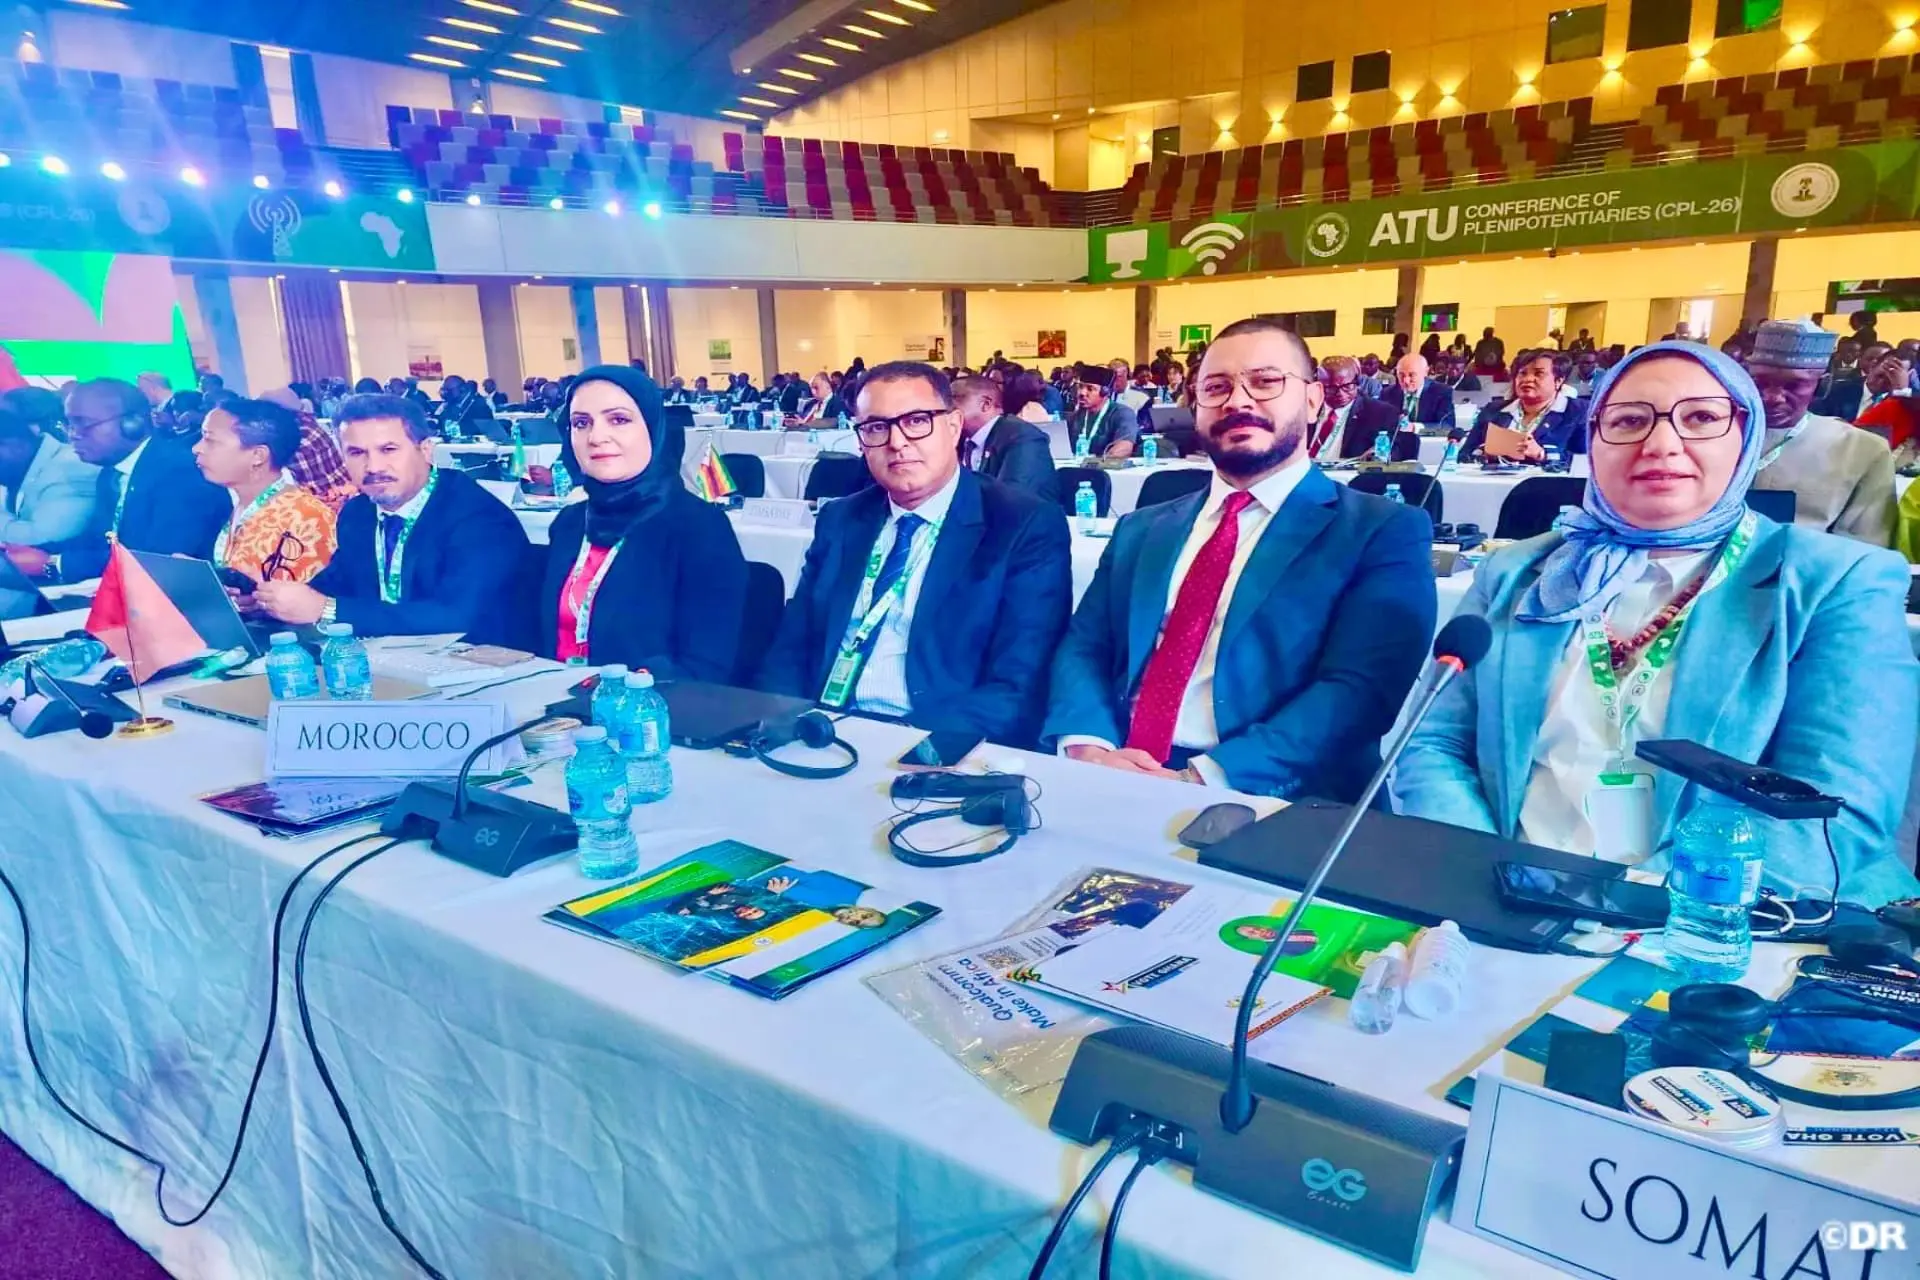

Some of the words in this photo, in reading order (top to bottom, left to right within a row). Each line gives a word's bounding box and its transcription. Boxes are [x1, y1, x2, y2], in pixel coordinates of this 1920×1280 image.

[1463, 205, 1651, 236] PLENIPOTENTIARIES
[1655, 196, 1743, 222] (CPL-26)
[1465, 193, 1591, 219] CONFERENCE
[1592, 190, 1621, 207] OF
[1369, 206, 1459, 247] ATU
[297, 721, 471, 751] MOROCCO
[959, 958, 1000, 987] Africa
[938, 964, 1013, 1021] Qualcomm
[997, 986, 1016, 1000] in
[1012, 997, 1057, 1029] Make
[1787, 1132, 1833, 1141] GHA
[1841, 1133, 1901, 1141] VOTE
